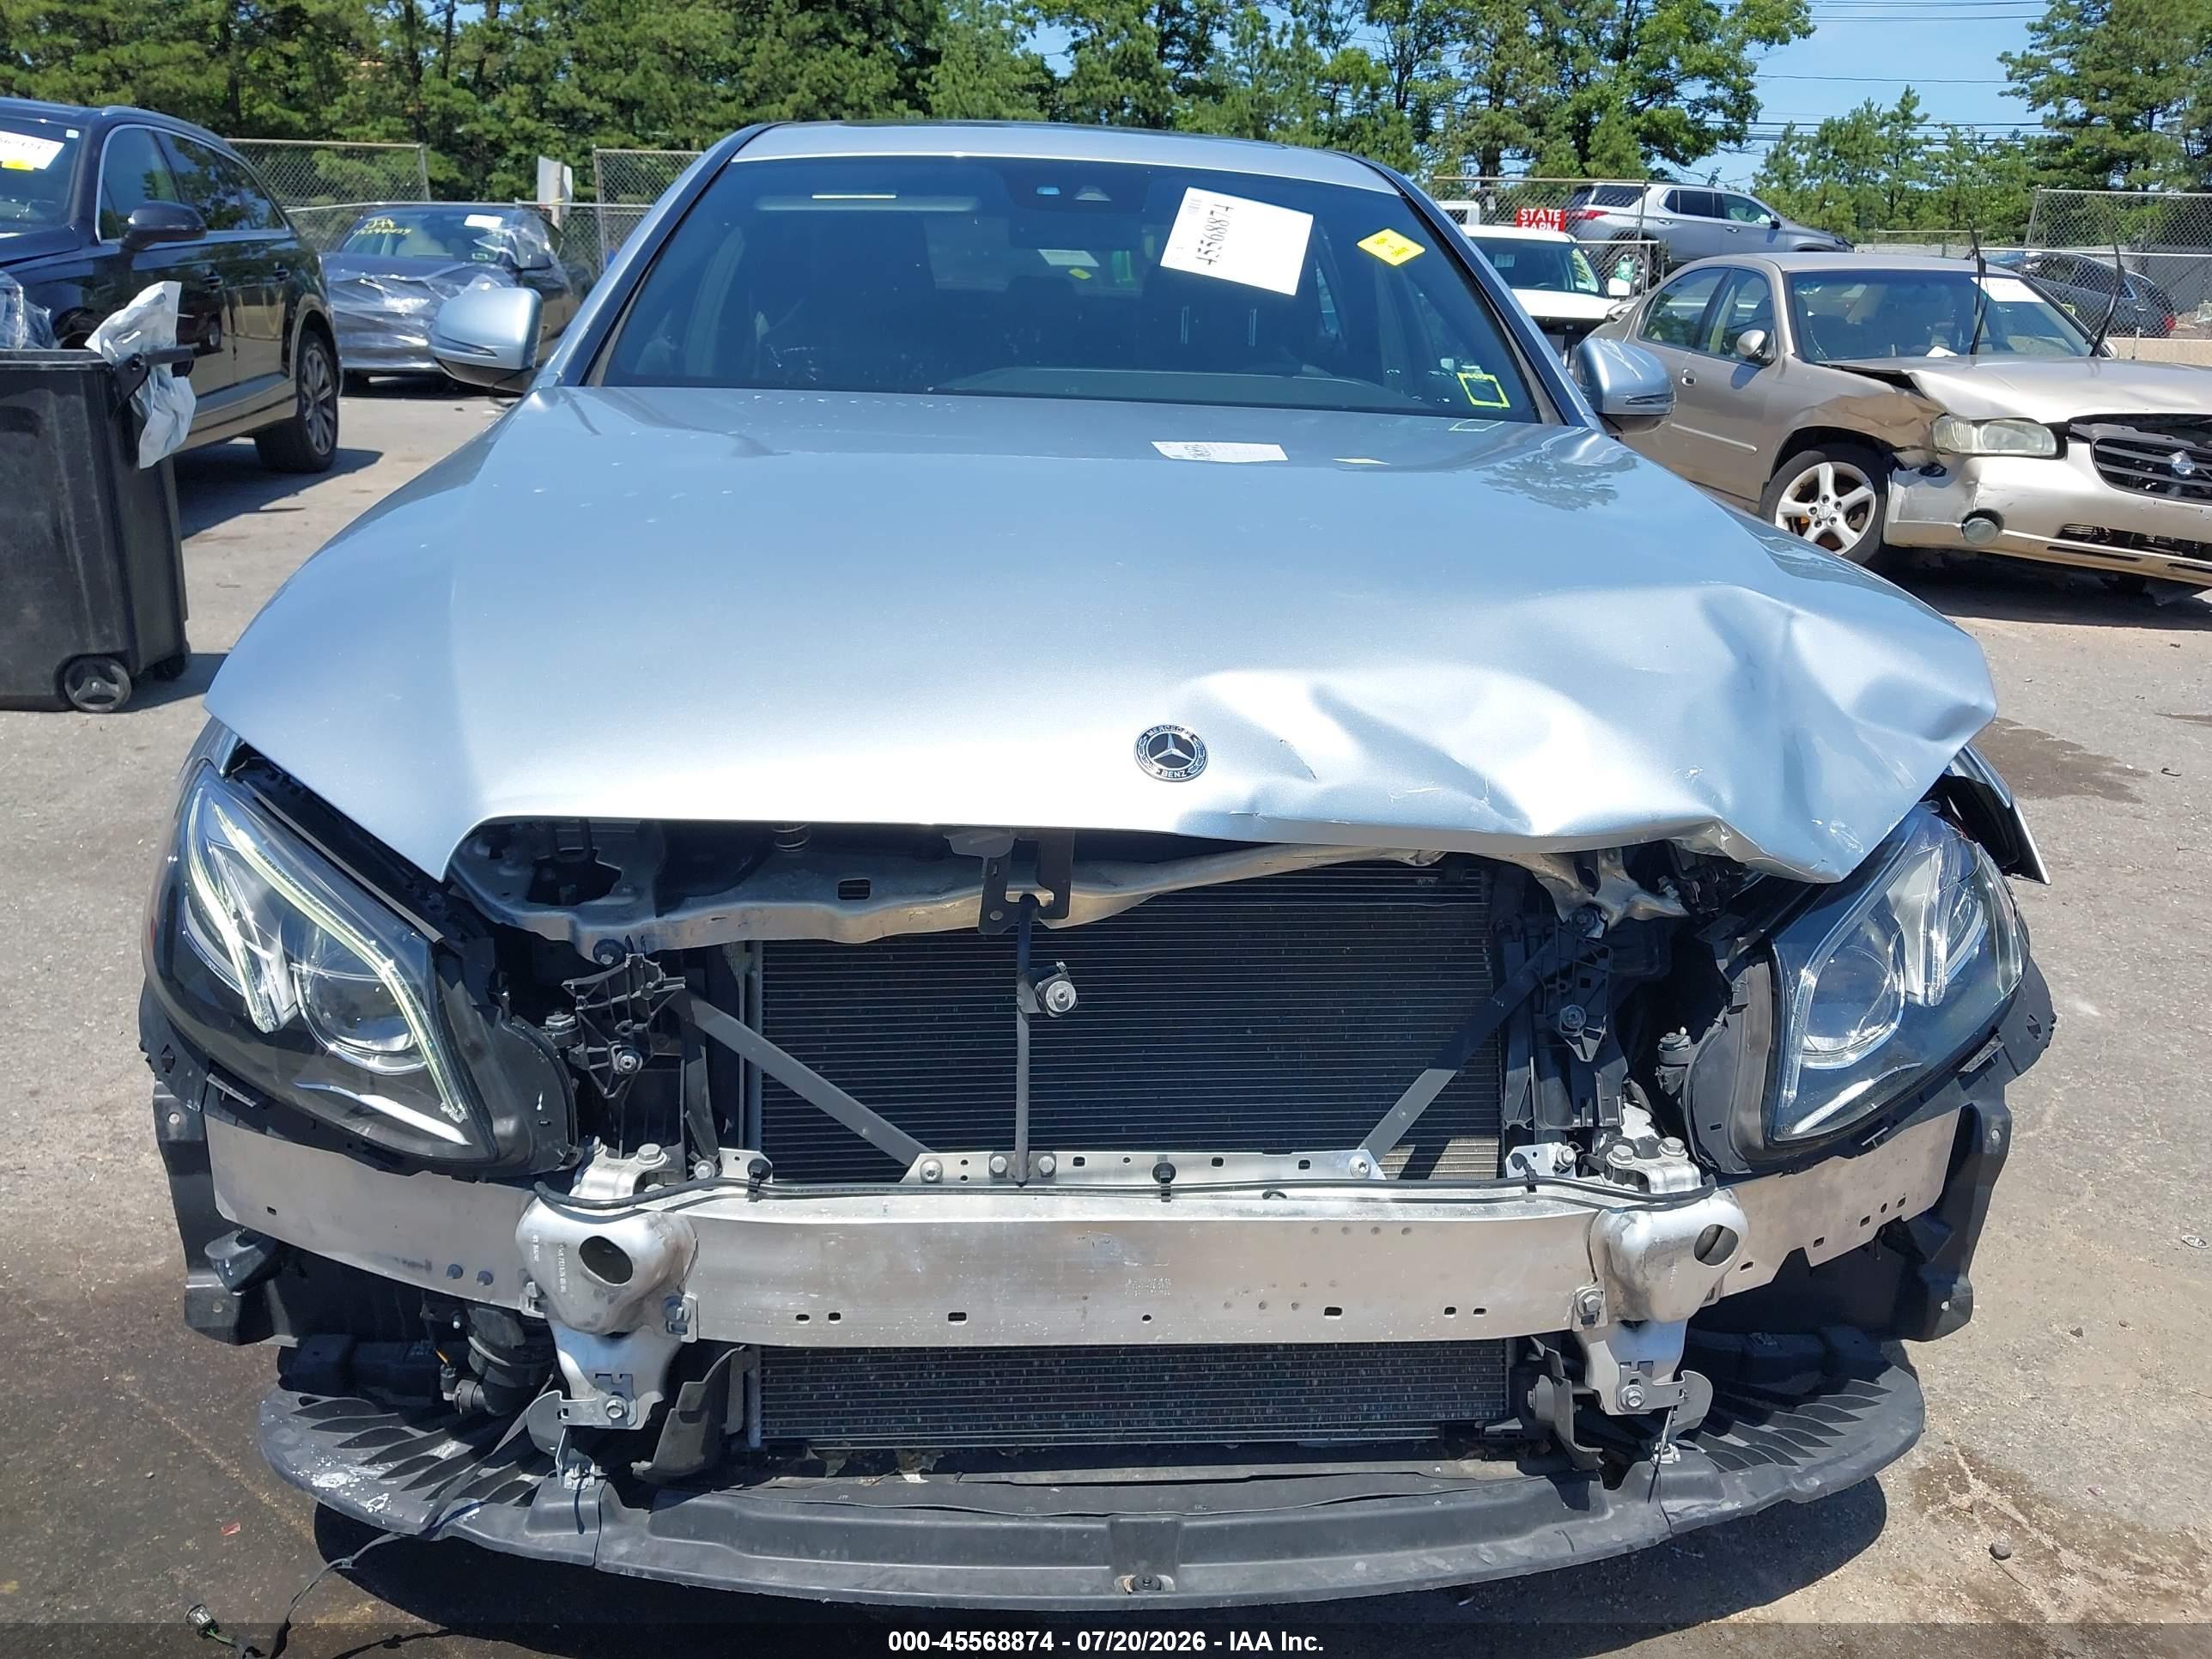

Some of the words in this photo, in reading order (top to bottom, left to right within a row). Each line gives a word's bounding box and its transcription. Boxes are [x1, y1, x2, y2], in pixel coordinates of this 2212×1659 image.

[1520, 208, 1562, 222] STATE
[1194, 204, 1235, 265] 45568874
[1146, 725, 1193, 738] MERCED
[1161, 769, 1187, 778] BENZ
